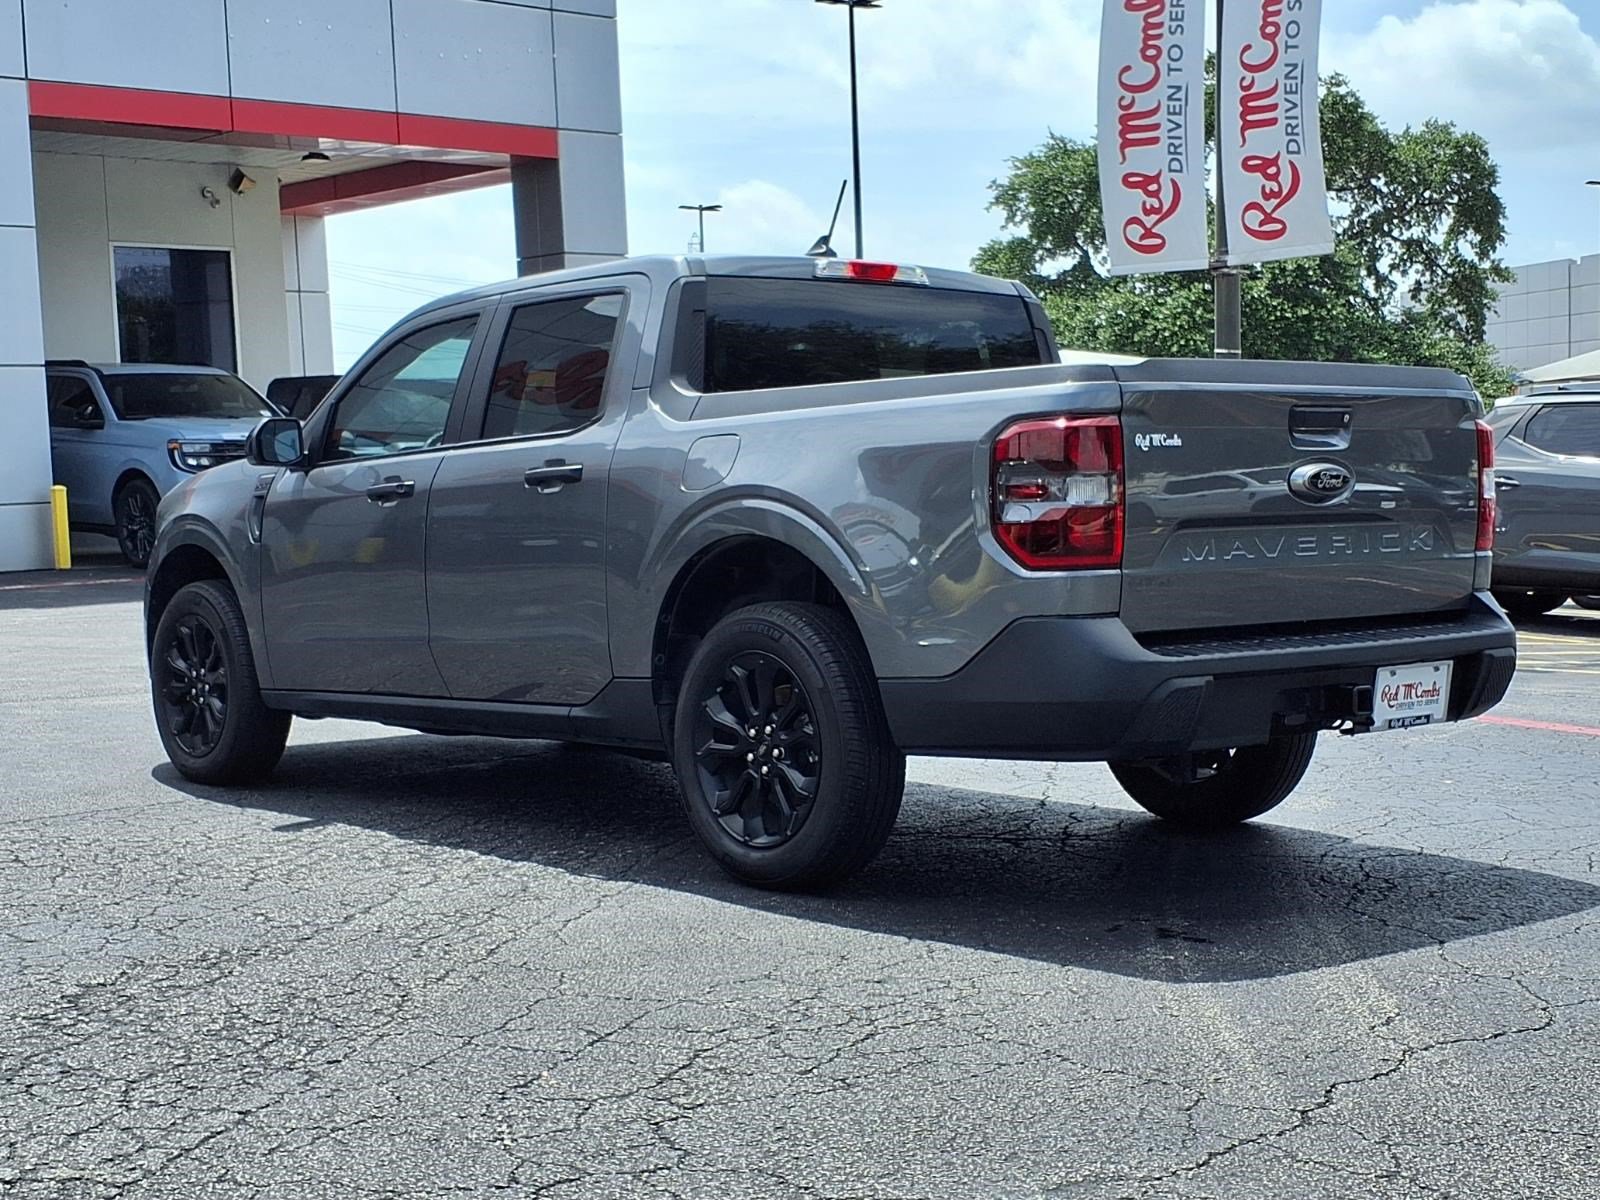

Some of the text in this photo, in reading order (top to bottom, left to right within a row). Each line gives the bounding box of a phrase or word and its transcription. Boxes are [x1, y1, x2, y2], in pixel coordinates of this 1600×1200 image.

[1284, 19, 1300, 54] TO
[1167, 43, 1183, 76] TO
[1284, 63, 1301, 155] DRIVEN
[1167, 84, 1183, 174] DRIVEN
[1122, 168, 1181, 255] Red
[1241, 151, 1300, 240] Red
[1317, 471, 1344, 489] Ford
[1182, 529, 1433, 561] MAVERICK
[1381, 680, 1441, 708] Red McCombs
[1396, 701, 1415, 709] DRIVEN
[1424, 698, 1439, 706] SERVE
